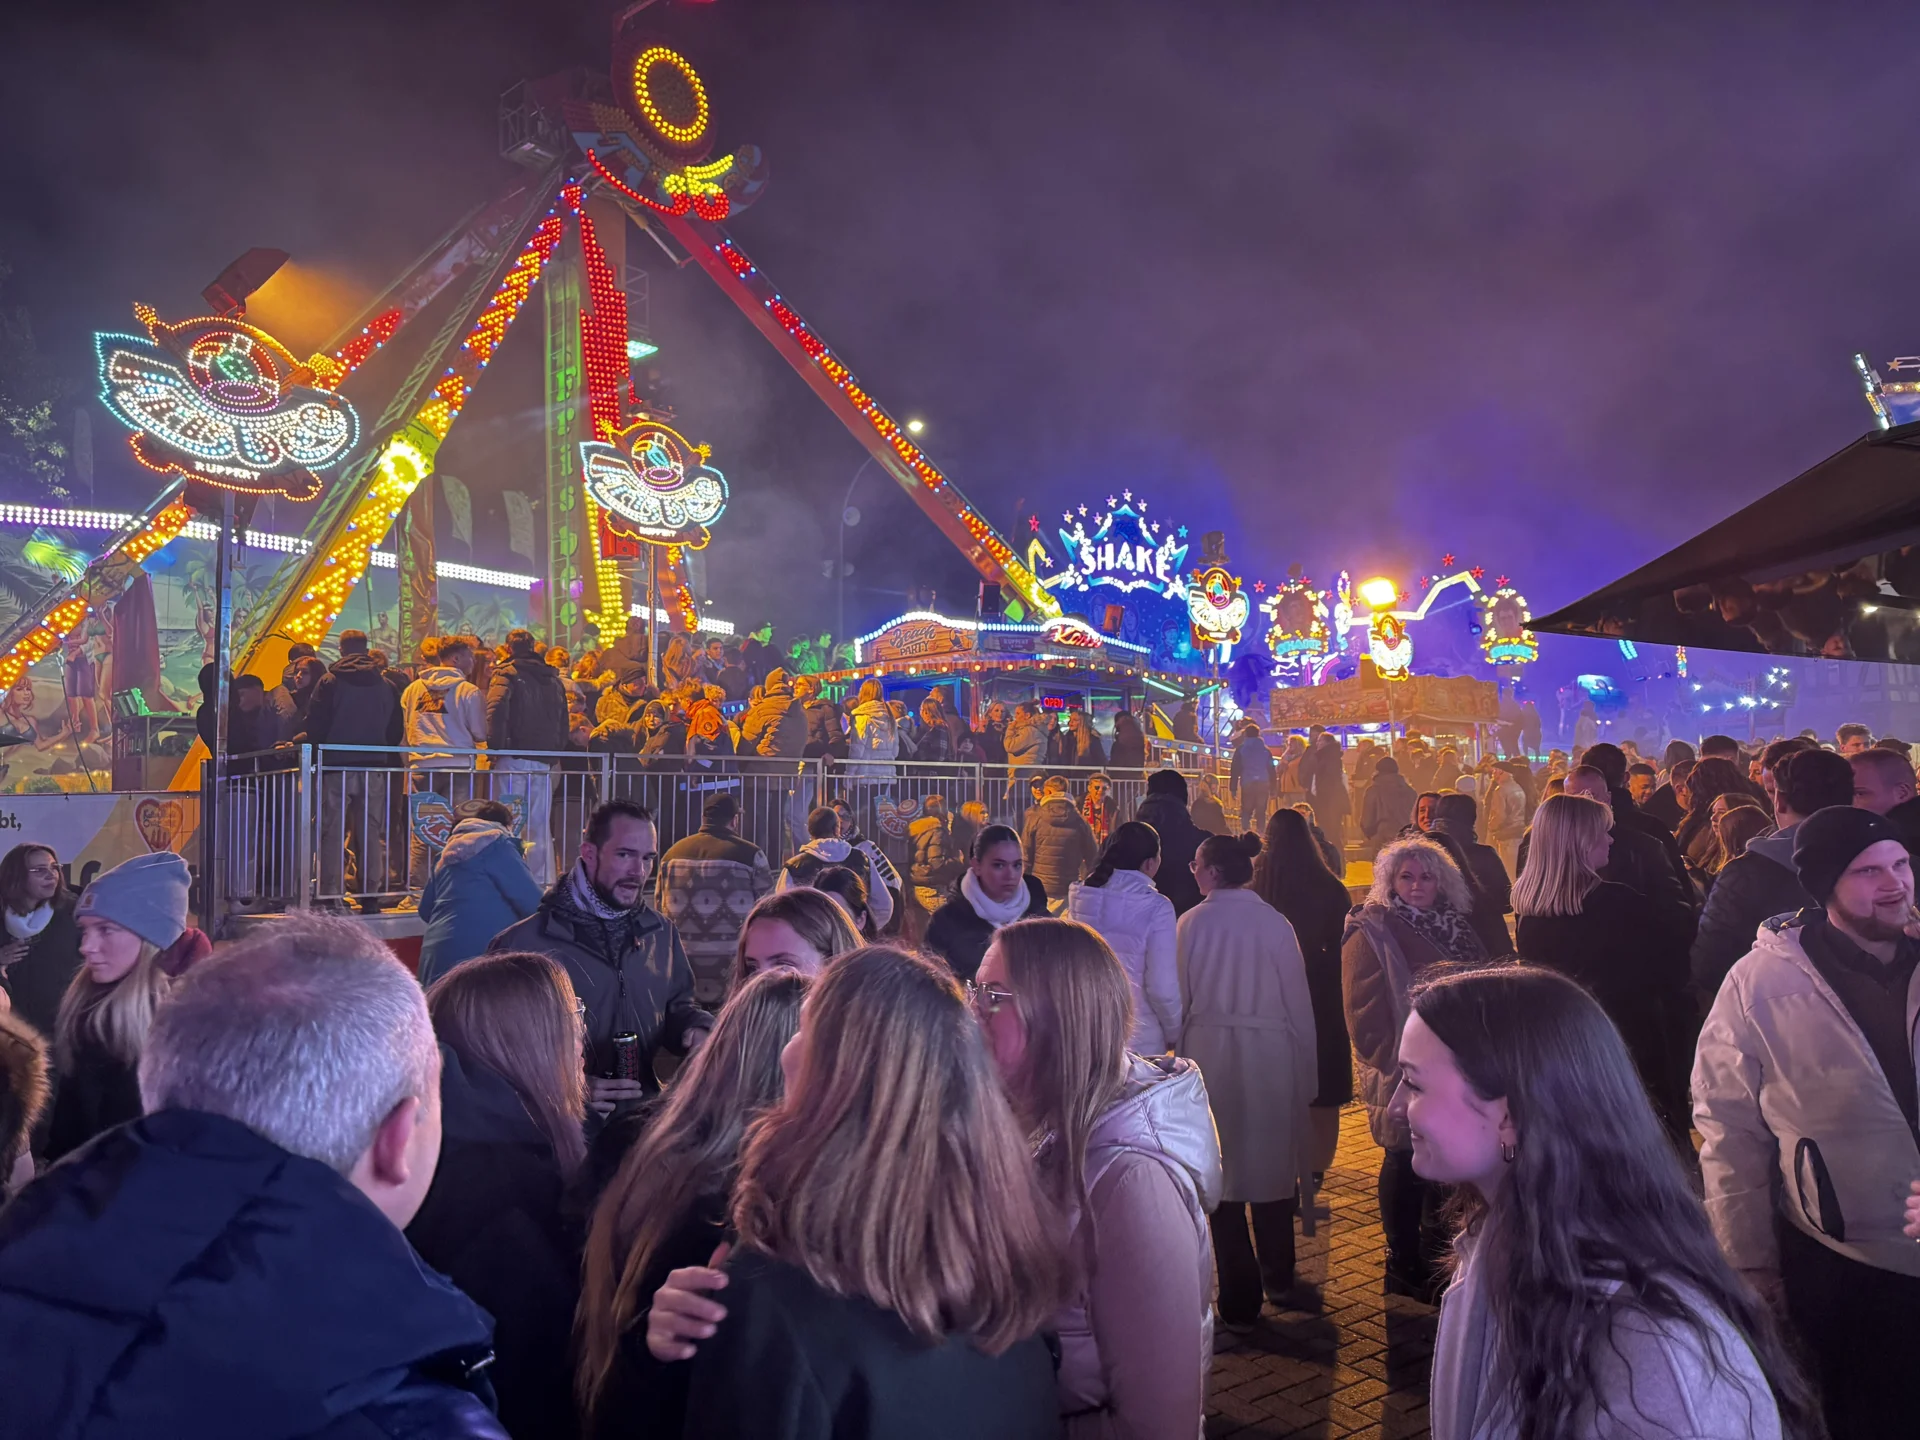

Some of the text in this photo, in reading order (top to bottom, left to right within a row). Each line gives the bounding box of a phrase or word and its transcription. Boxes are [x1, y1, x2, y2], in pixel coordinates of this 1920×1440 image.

[194, 461, 261, 481] RUPPERT
[1081, 542, 1172, 583] SHAKE
[890, 624, 937, 648] Beach
[900, 640, 929, 656] PARTY
[1043, 697, 1064, 709] OPEN
